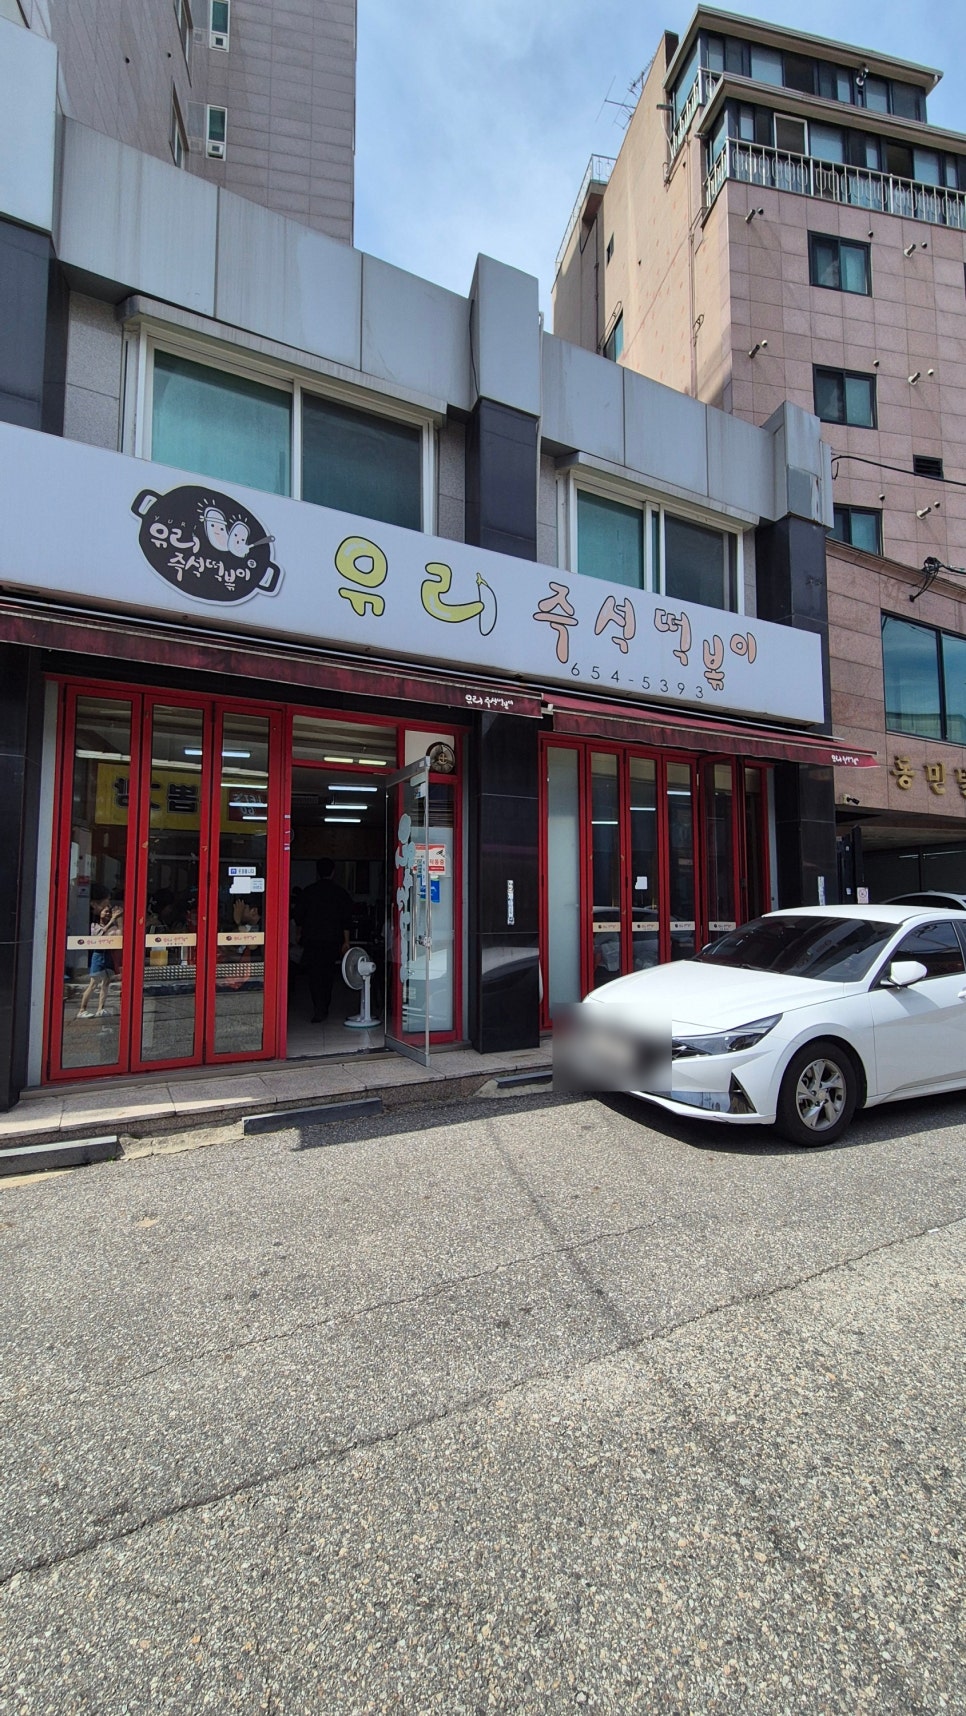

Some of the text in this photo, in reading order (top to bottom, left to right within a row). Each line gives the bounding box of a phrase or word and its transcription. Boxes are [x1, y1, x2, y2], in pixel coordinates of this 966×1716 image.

[149, 522, 201, 553] 유리
[167, 551, 251, 591] 즉석떡볶이
[334, 535, 757, 691] 유리 즉석떡볶이
[571, 662, 704, 699] 654-5393
